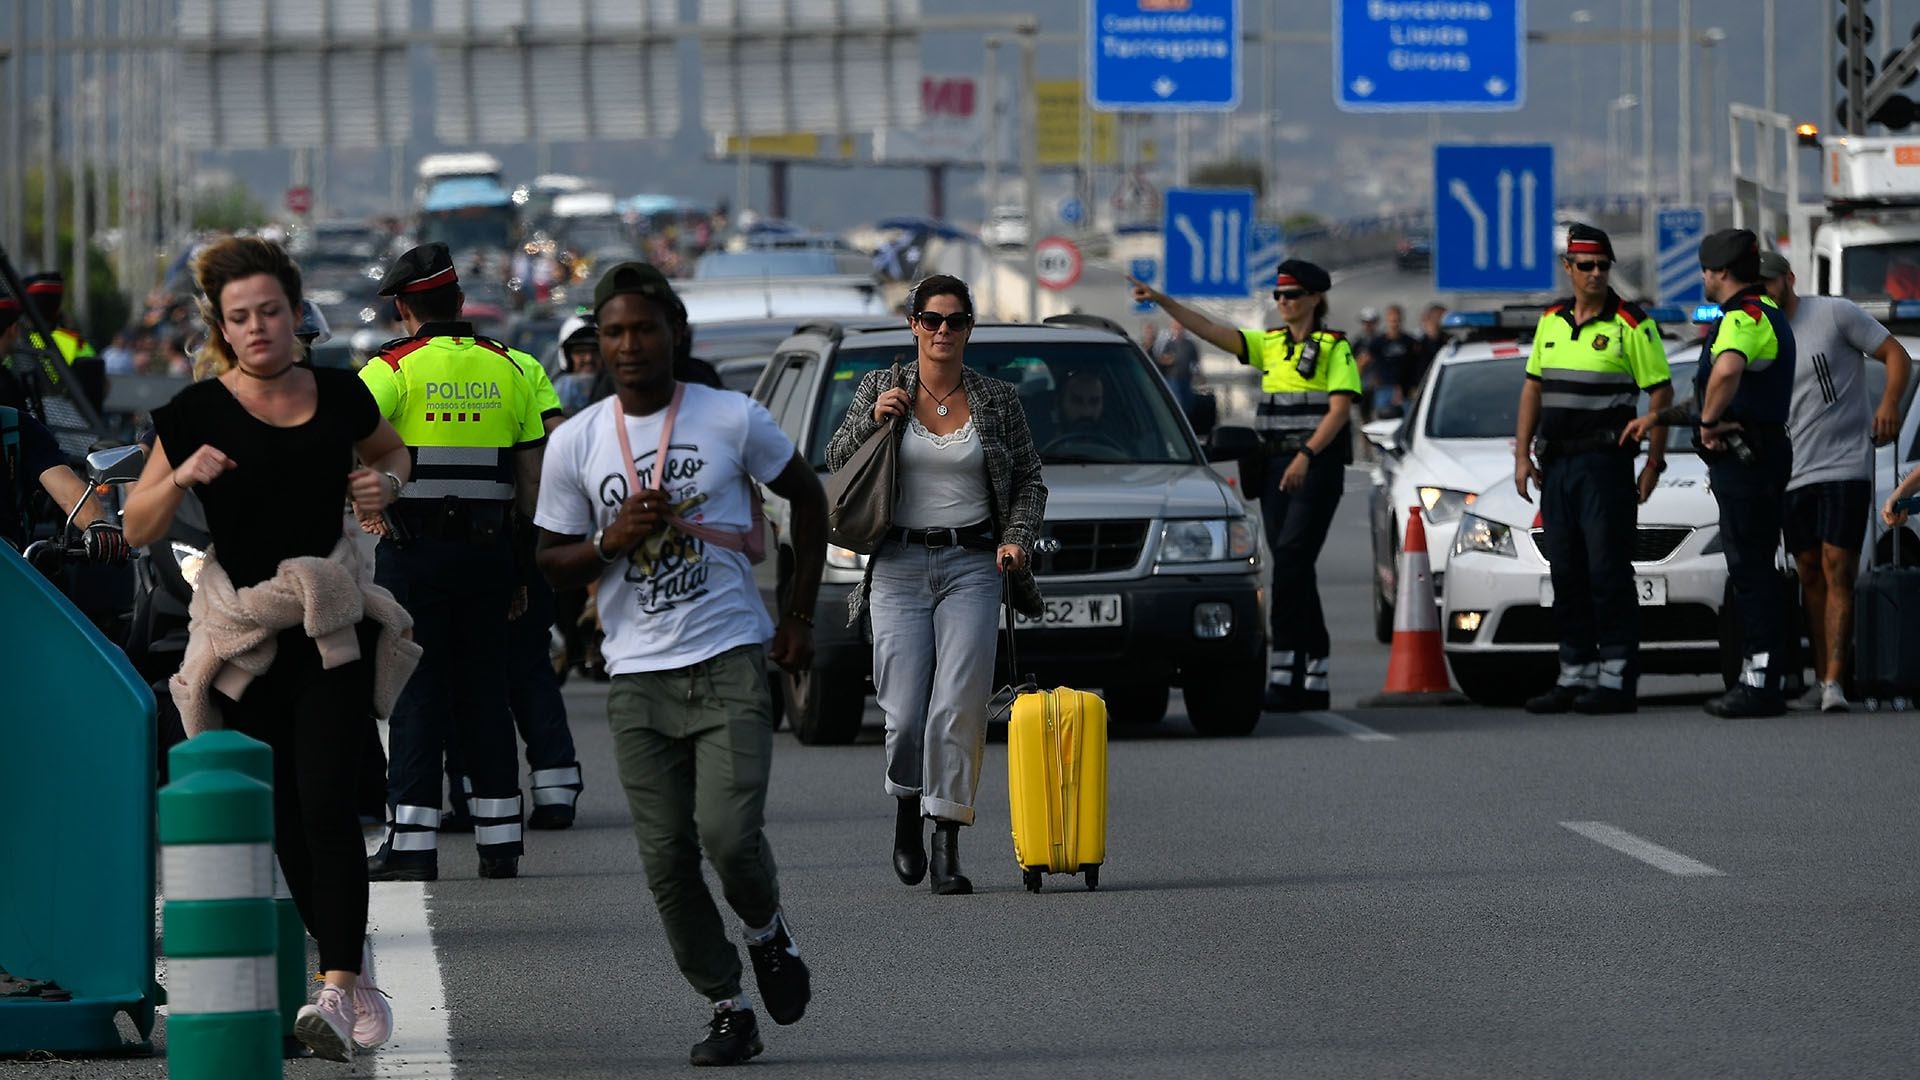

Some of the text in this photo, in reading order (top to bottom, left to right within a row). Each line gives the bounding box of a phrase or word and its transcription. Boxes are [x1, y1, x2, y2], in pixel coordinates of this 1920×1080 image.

[426, 382, 501, 400] POLICIA
[427, 401, 458, 410] mossos
[1015, 599, 1118, 624] 52 WJ
